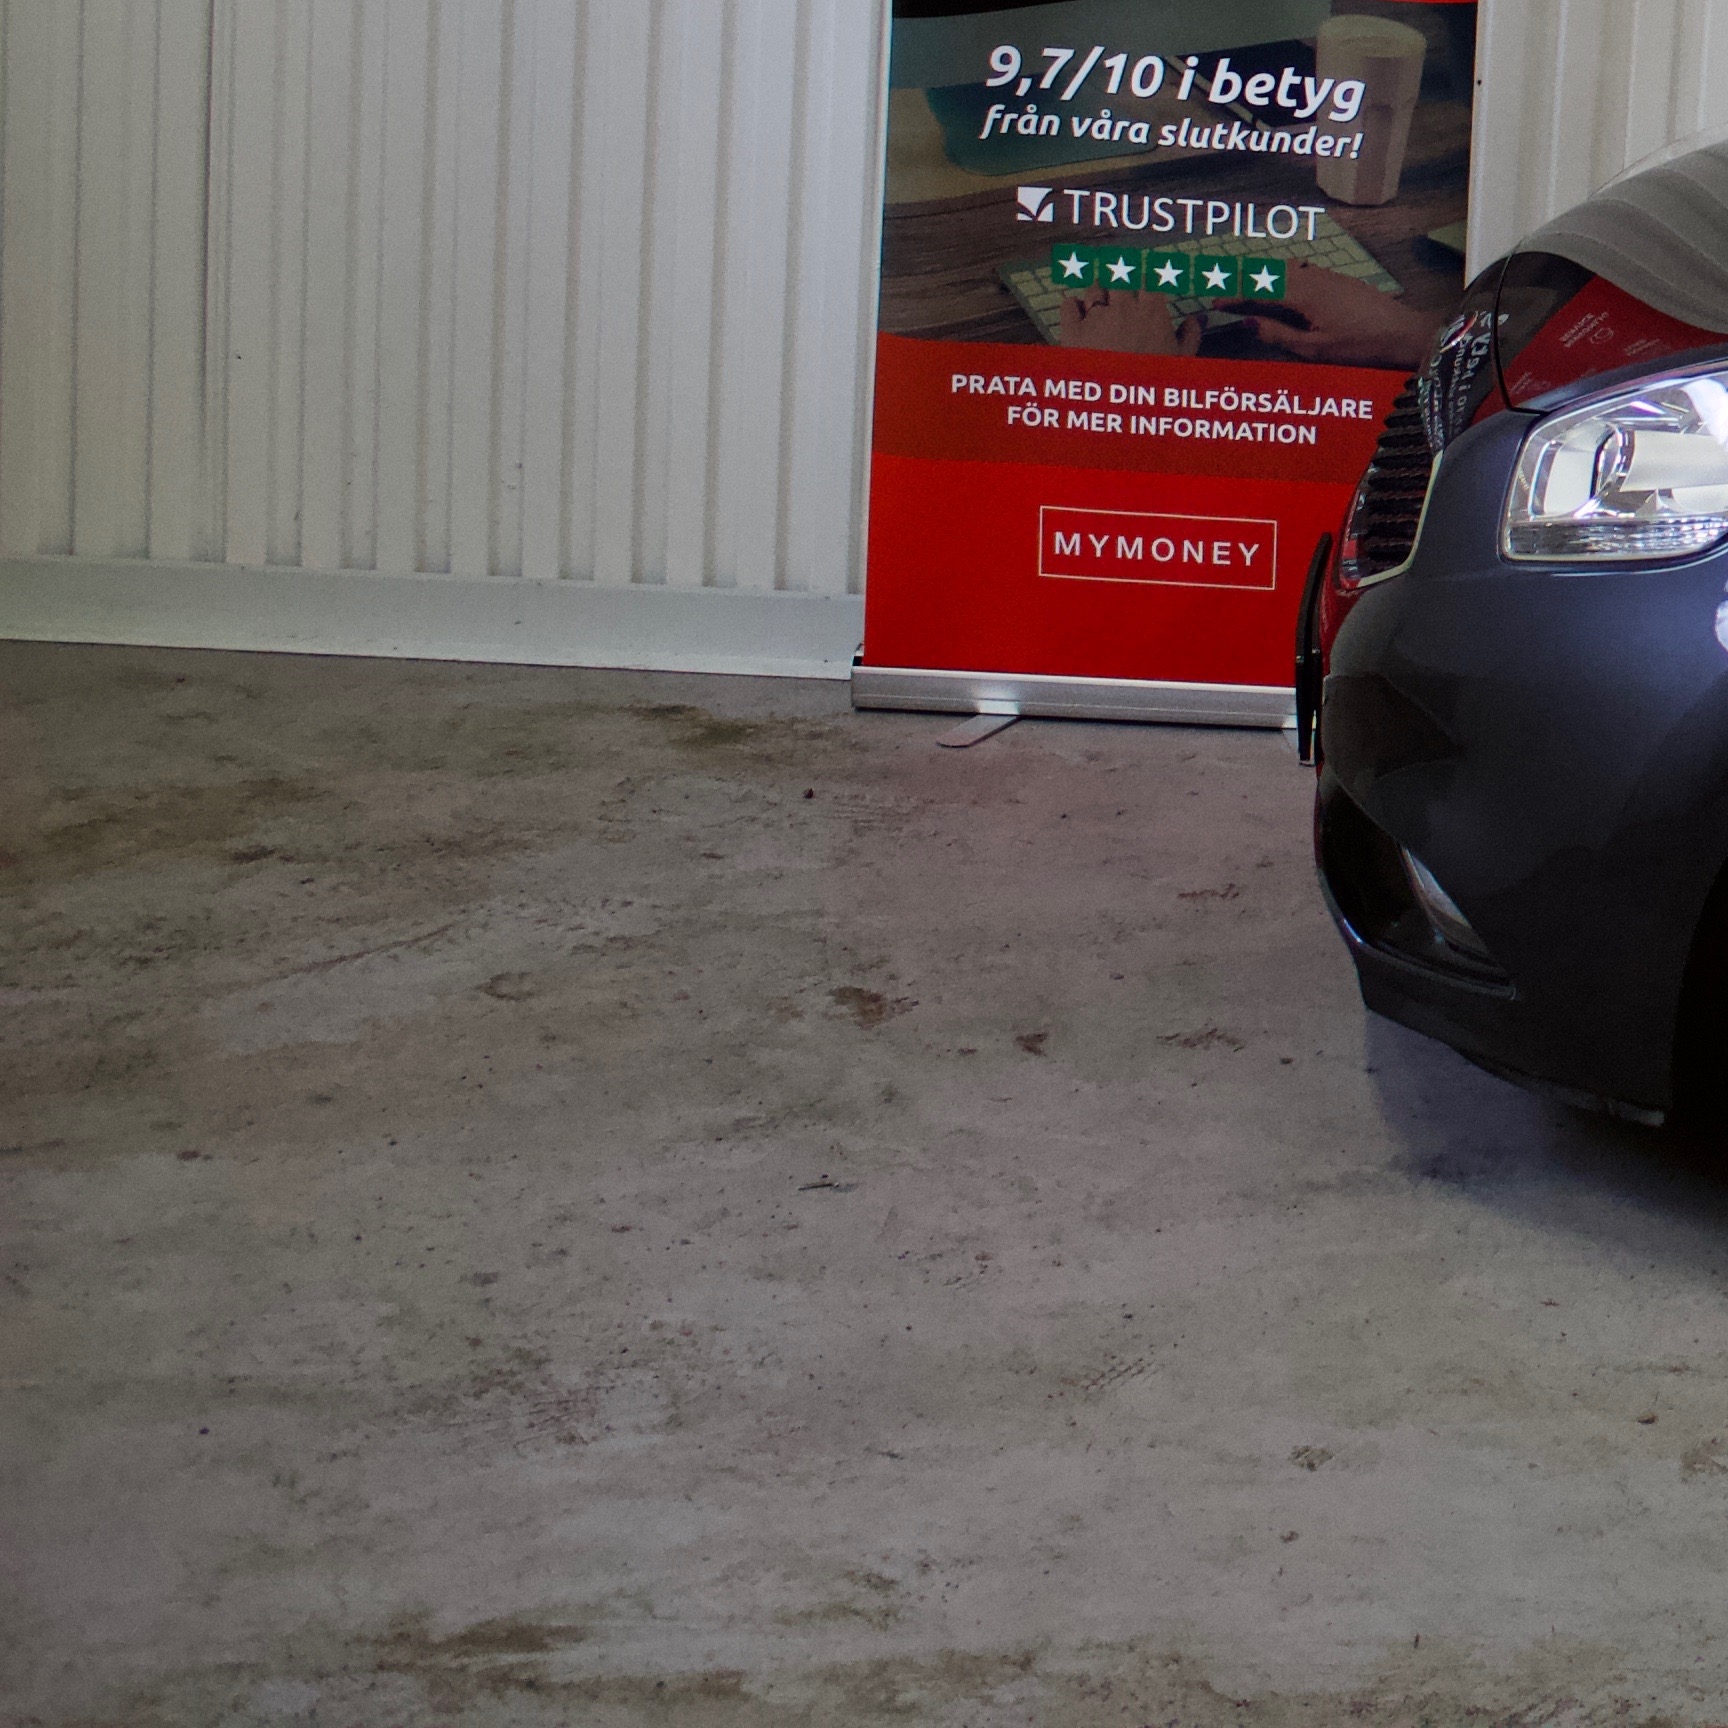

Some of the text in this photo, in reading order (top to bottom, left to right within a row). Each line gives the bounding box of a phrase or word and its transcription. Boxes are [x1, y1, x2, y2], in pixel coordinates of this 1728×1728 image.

[985, 45, 1366, 122] 9,7/10 i betyg
[979, 103, 1364, 160] från våra slutkunder!
[1063, 188, 1326, 241] TRUSTPILOT
[951, 374, 1373, 420] PRATA MED DIN BILFÖRSÄLJARE
[1007, 401, 1317, 445] FÖR MER INFORMATION
[1054, 531, 1260, 567] MYMONEY
